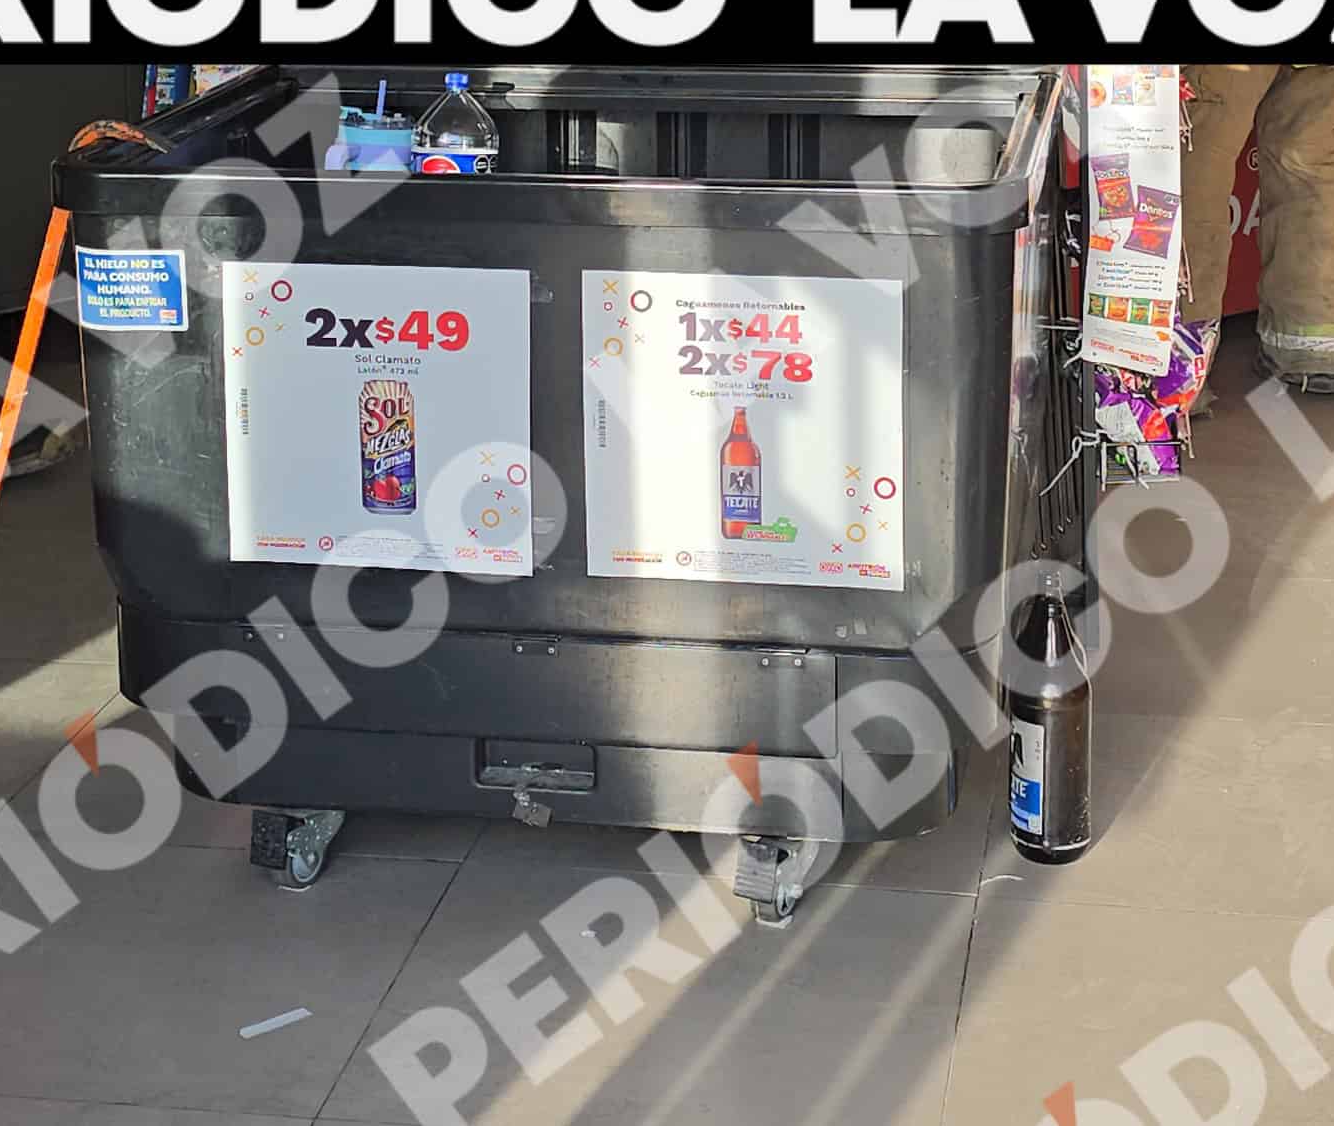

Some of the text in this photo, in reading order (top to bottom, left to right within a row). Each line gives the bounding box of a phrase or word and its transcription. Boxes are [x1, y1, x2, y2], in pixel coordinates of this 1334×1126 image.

[83, 270, 170, 283] PARA CONSUMO
[95, 257, 128, 269] HIELO
[130, 258, 149, 269] NO
[152, 258, 166, 269] ES
[305, 308, 470, 352] 2x$49
[678, 312, 803, 345] 1x$44
[354, 354, 422, 365] Sol Clamato
[678, 345, 813, 383] 2x$78
[364, 395, 411, 435] SOL
[366, 428, 411, 456] MEZCLAS
